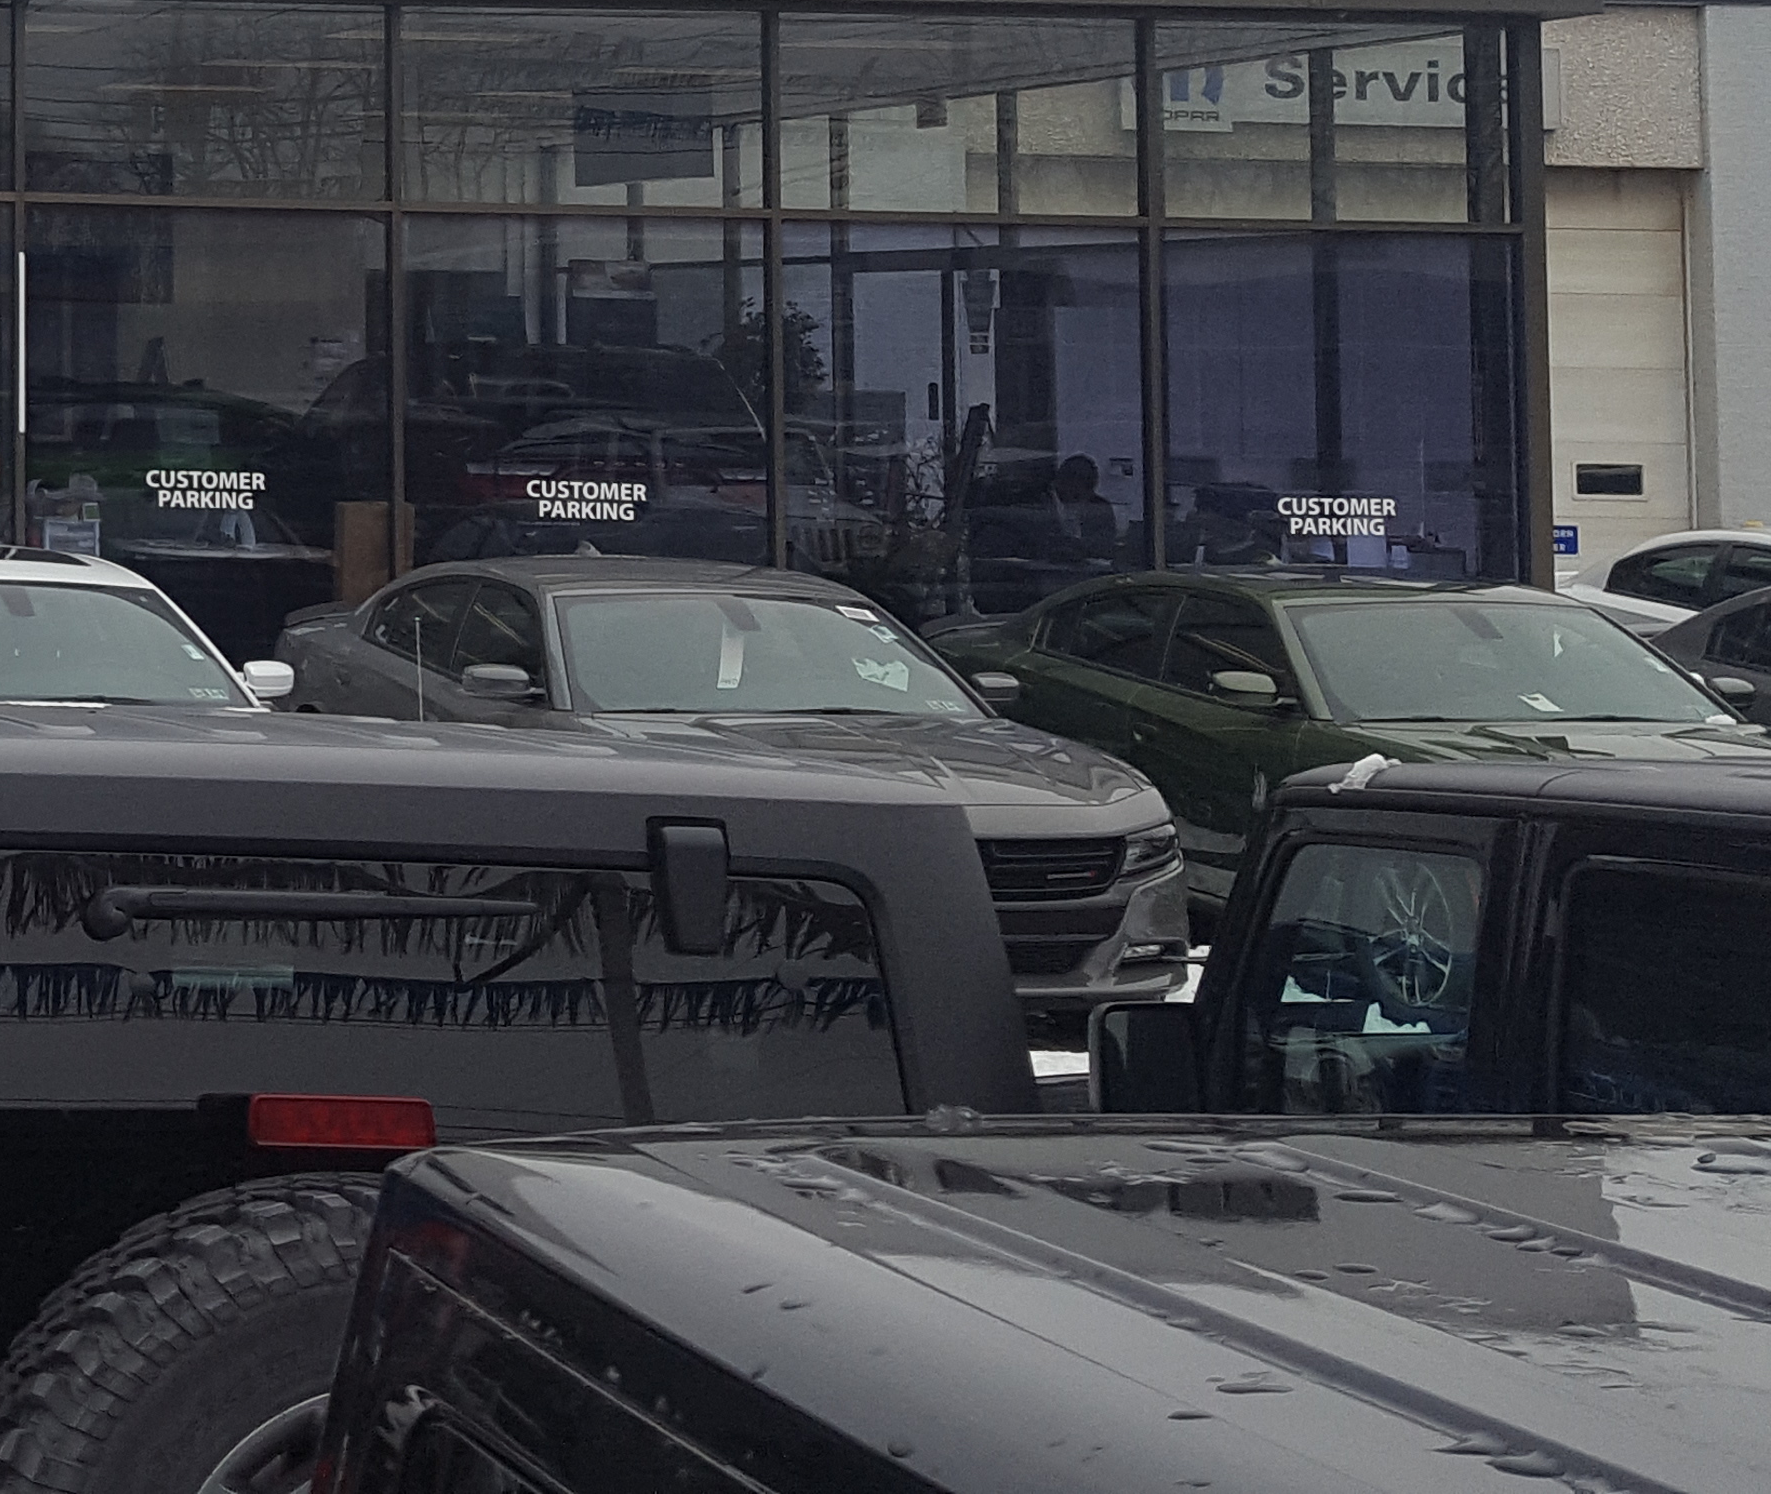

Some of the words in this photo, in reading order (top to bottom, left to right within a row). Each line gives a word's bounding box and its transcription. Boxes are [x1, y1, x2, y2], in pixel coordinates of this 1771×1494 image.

[1264, 56, 1506, 103] Srvic
[1162, 110, 1220, 121] OPAR
[145, 469, 266, 491] CUSTOMER
[526, 479, 647, 502] CUSTOMER
[158, 489, 254, 510] PARKING
[539, 499, 635, 521] PARKING
[1277, 497, 1397, 517] CUSTOMER
[1290, 517, 1385, 536] PARKING
